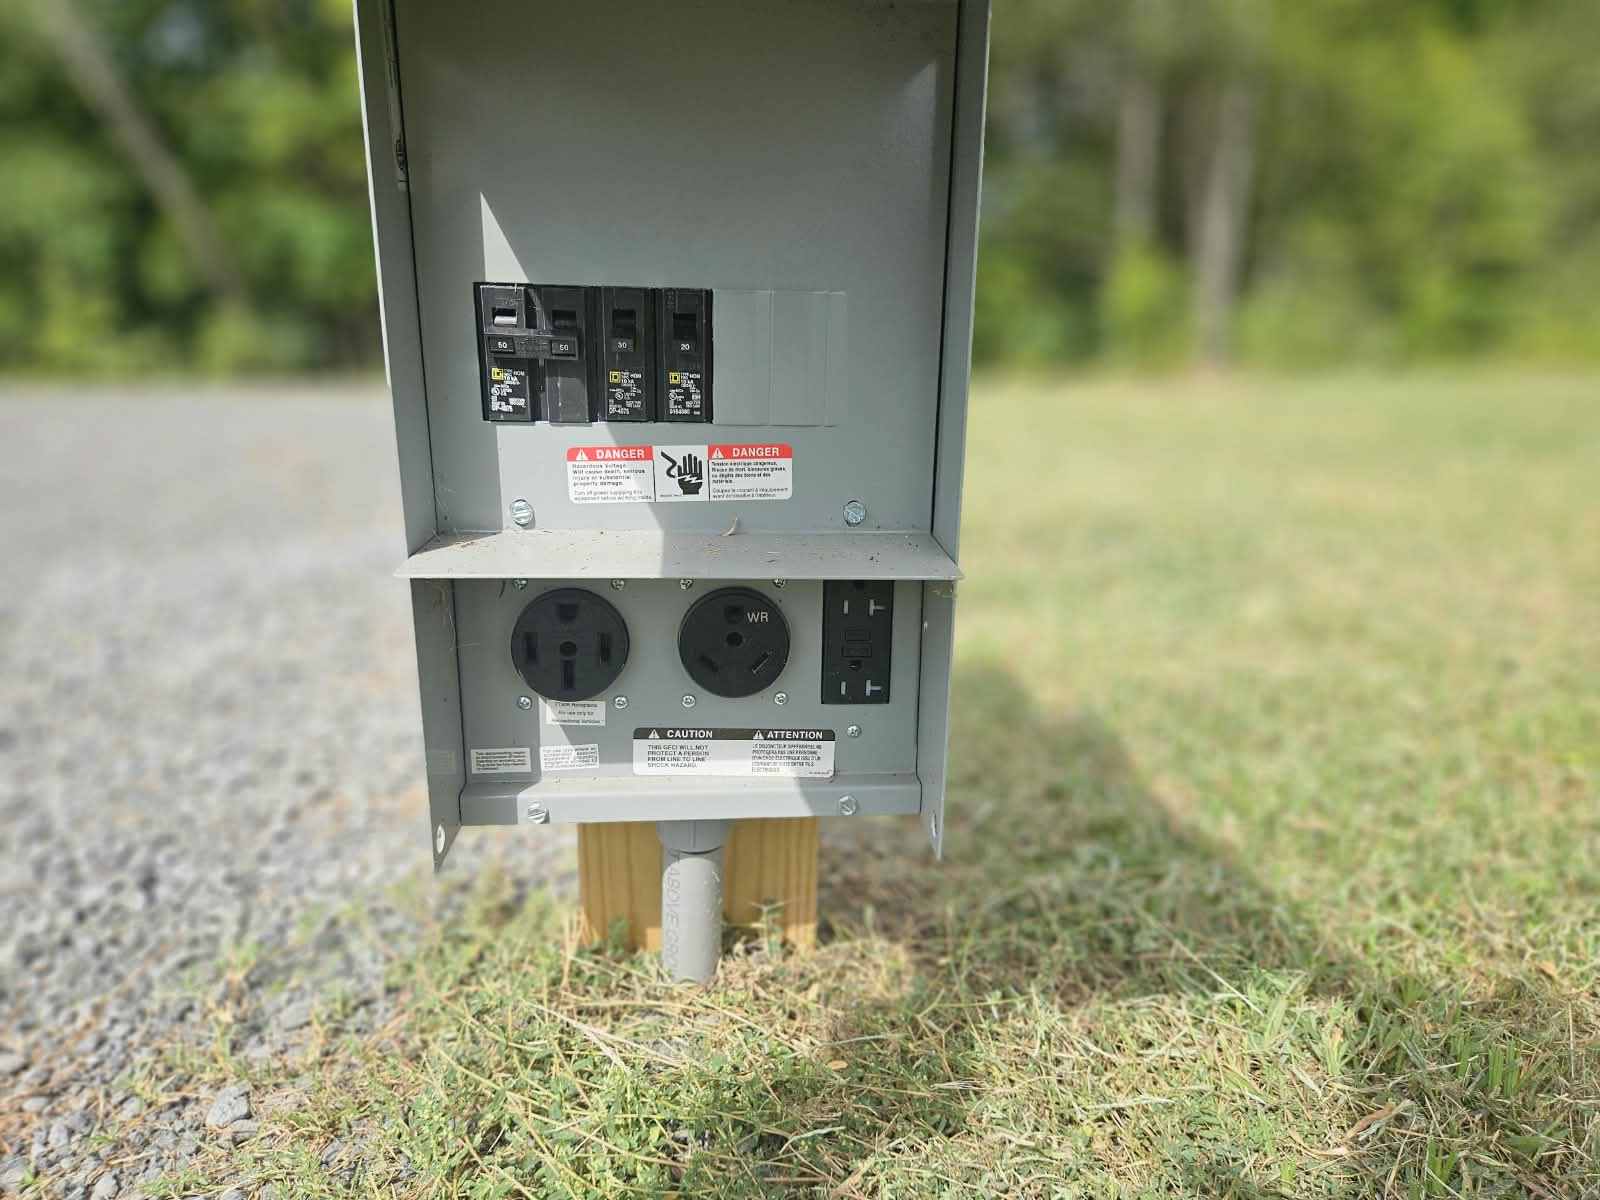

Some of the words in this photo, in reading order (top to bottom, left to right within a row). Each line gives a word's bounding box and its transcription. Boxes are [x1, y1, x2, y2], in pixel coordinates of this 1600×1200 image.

[498, 341, 508, 349] 50
[681, 343, 690, 351] 20
[595, 448, 645, 460] DANGER
[732, 447, 780, 457] DANGER
[746, 611, 769, 623] WR
[666, 729, 713, 739] CAUTION
[767, 730, 823, 740] ATTENTION
